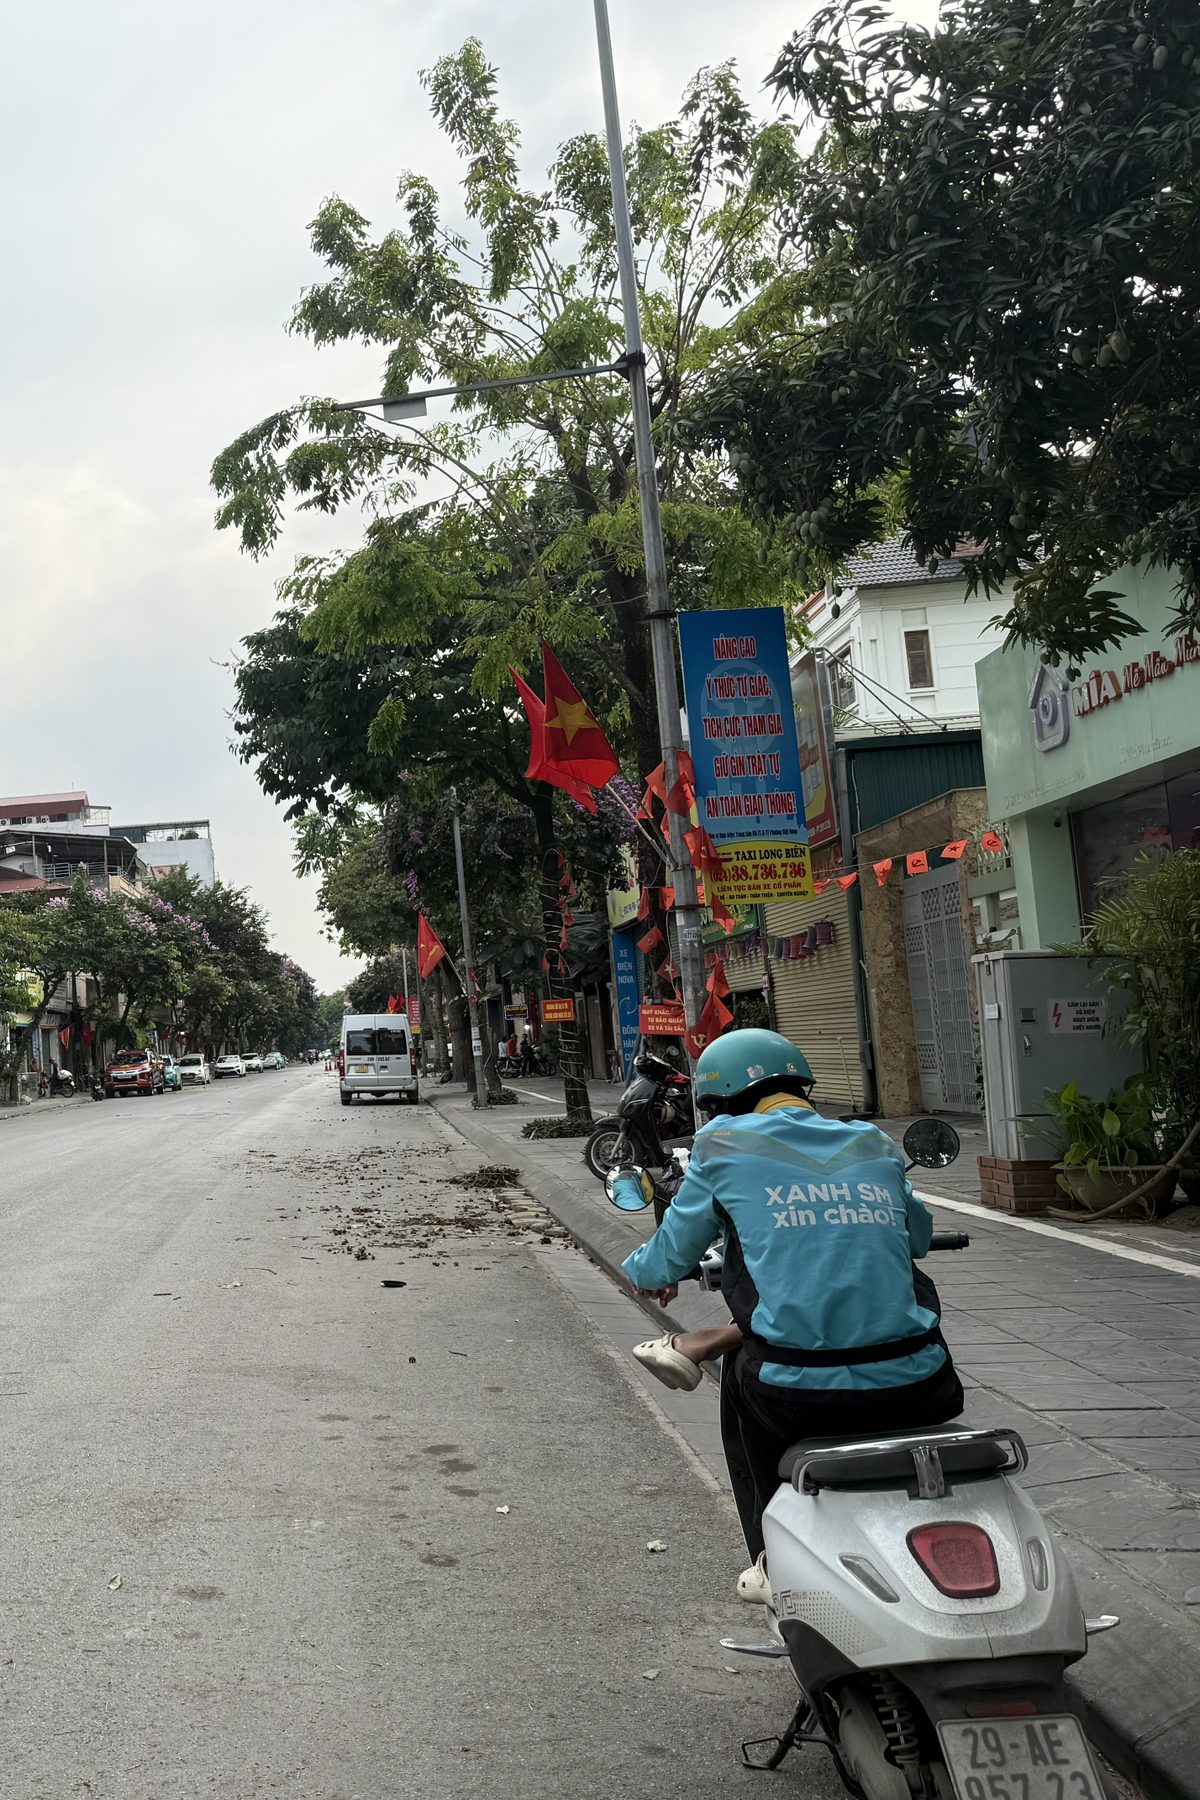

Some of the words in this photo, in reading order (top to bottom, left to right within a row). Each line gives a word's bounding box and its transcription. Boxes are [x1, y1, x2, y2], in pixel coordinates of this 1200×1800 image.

[713, 633, 738, 660] NÂNG
[740, 636, 757, 658] CAO
[706, 673, 713, 699] Ý
[714, 672, 736, 699] THỨC
[736, 674, 748, 702] TỰ
[749, 671, 772, 698] GIÁC,
[703, 713, 722, 739] TÍCH
[724, 715, 741, 742] CỰC
[742, 714, 767, 736] THAM
[767, 713, 784, 736] GIA
[714, 751, 729, 778] GIỮ
[730, 751, 746, 777] GÌN
[746, 750, 768, 781] TRẬT
[768, 751, 780, 780] TỰ
[706, 797, 719, 818] AN
[719, 791, 743, 817] TOÀN
[743, 793, 765, 817] GIAO
[765, 787, 797, 815] THÔNG!
[734, 849, 757, 861] TAXI
[759, 848, 783, 860] LONG
[785, 845, 806, 859] BIÊN
[734, 884, 746, 893] TỤC
[619, 949, 628, 957] XE
[617, 961, 632, 972] ĐIỆN
[764, 1183, 851, 1206] XANH
[857, 1183, 892, 1205] SM
[771, 1205, 816, 1229] xin
[823, 1203, 897, 1227] chào!
[961, 1723, 1070, 1769] 29-AE
